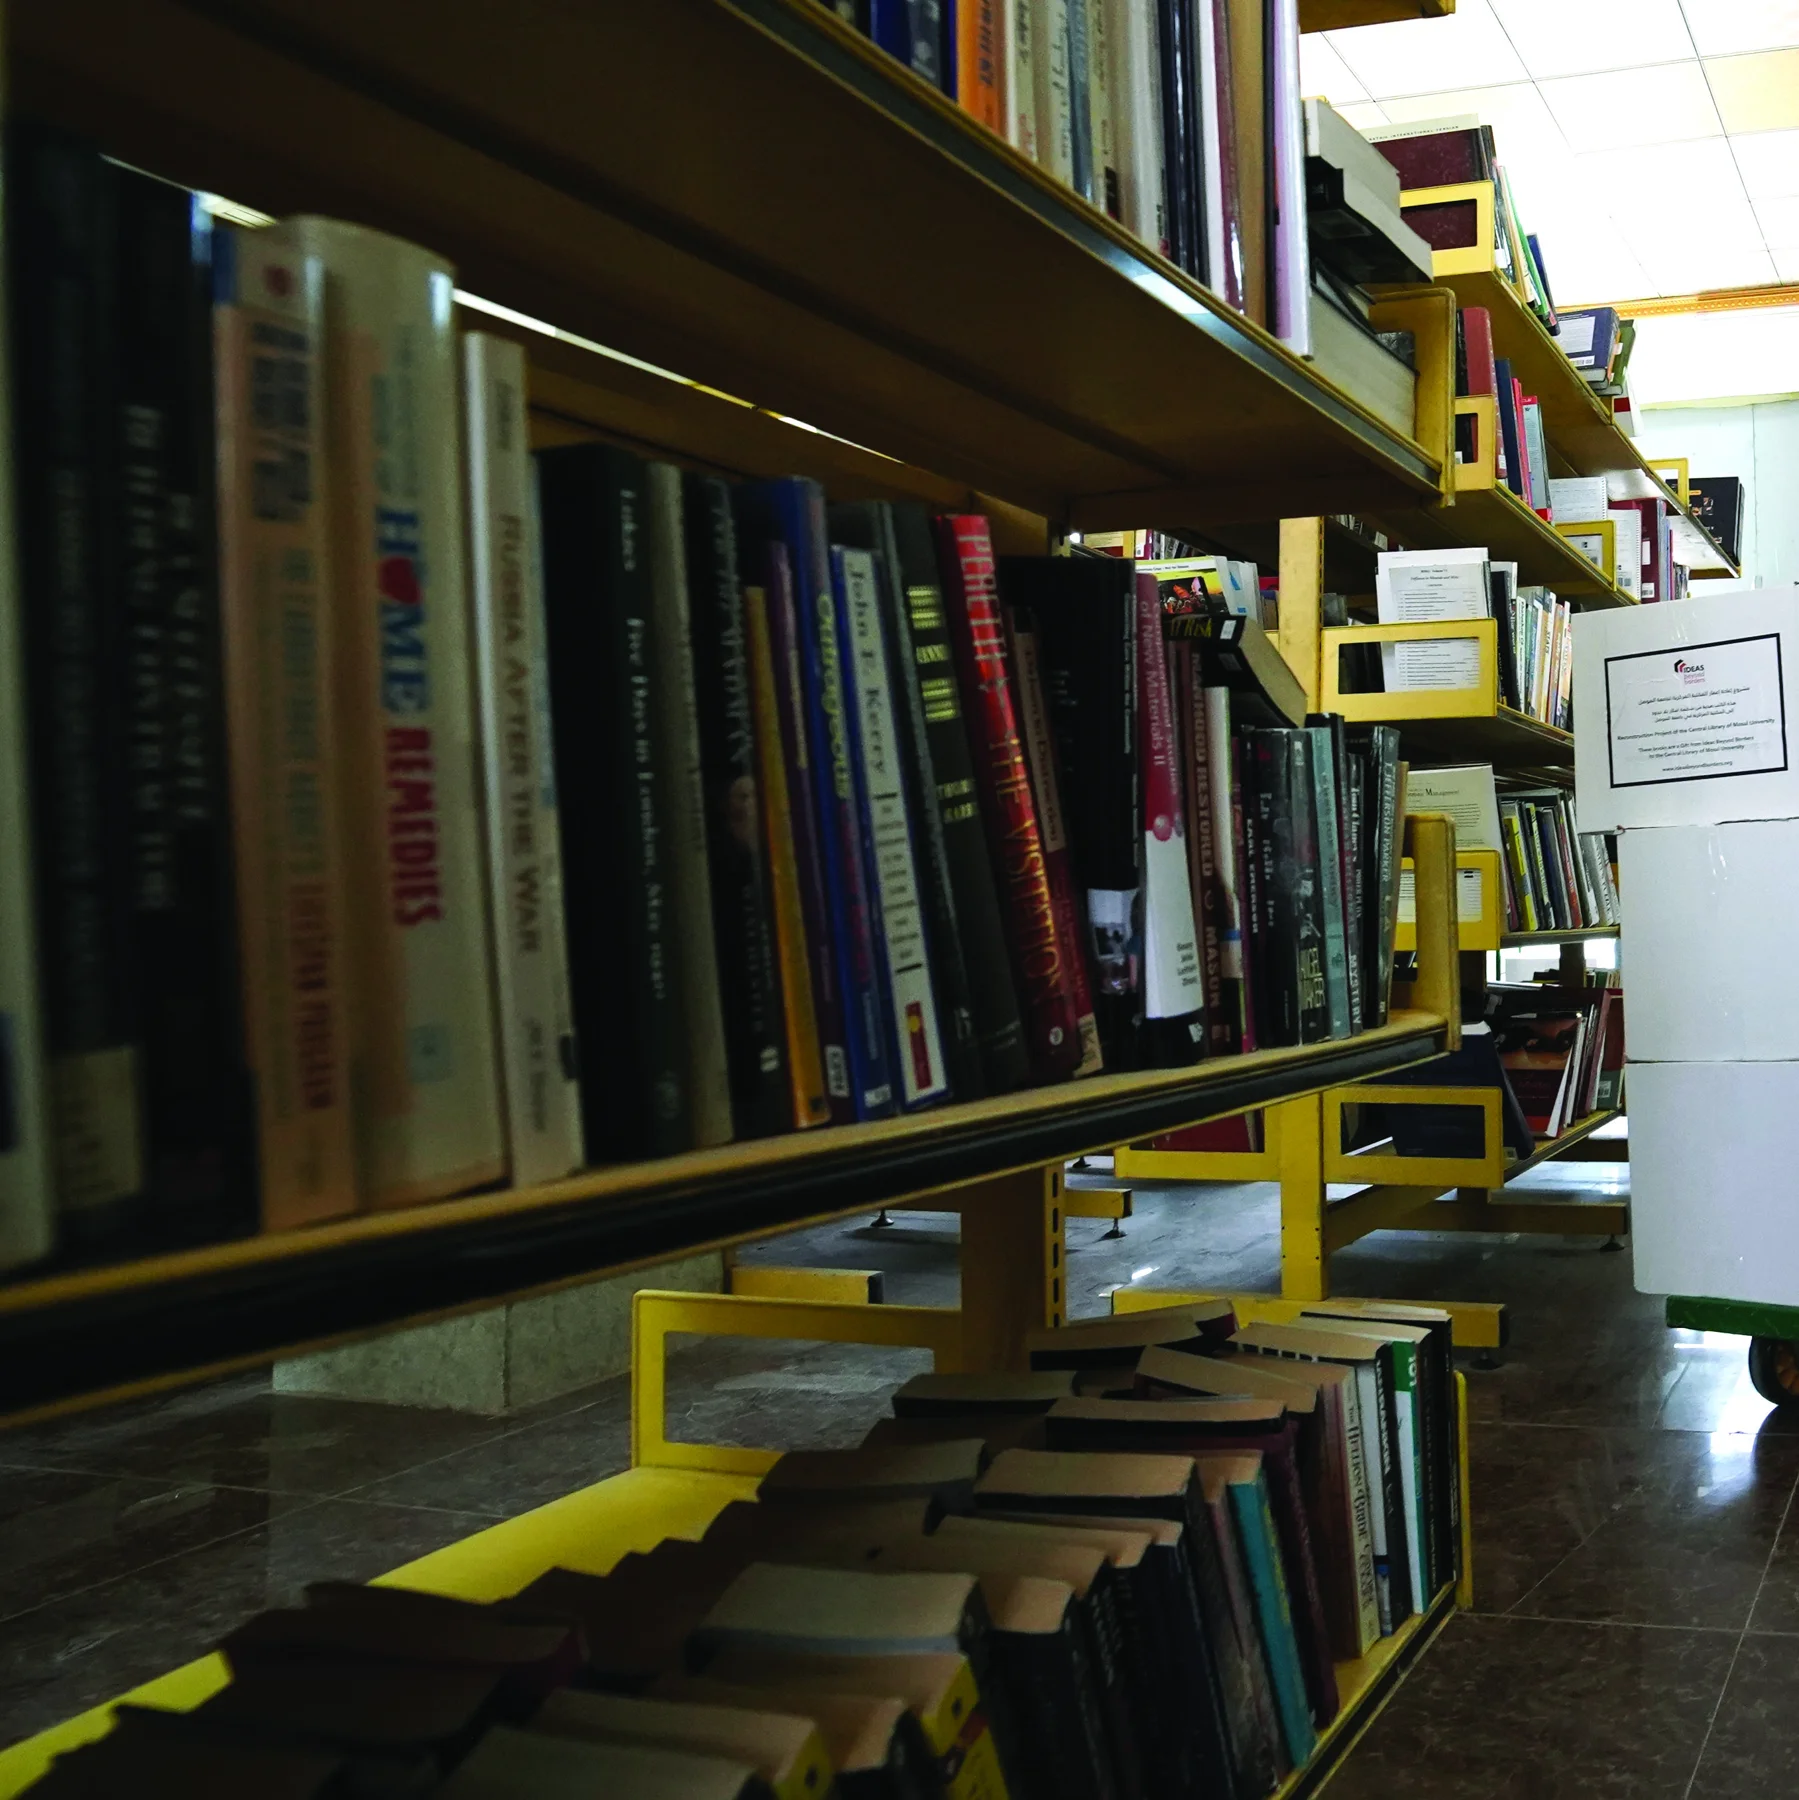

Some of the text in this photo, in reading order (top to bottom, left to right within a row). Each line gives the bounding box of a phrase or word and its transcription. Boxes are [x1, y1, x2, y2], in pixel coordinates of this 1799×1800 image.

[373, 506, 434, 715] HOME
[625, 618, 646, 667] Five
[847, 563, 869, 637] John
[865, 687, 888, 775] Kerry
[1139, 601, 1166, 766] of New Materials II
[1684, 664, 1705, 673] IDEAS
[496, 513, 545, 953] RUSSIA AFTER THE WAR
[631, 675, 650, 733] Days
[1749, 718, 1775, 726] University
[634, 739, 652, 763] in
[956, 533, 1009, 663] PERETTI
[1003, 818, 1063, 1007] VISITATION
[383, 726, 444, 927] REMEDIES
[1190, 652, 1221, 1009] MANHOOD RESTORED MASON
[1382, 770, 1393, 835] JEFFERSON
[1381, 837, 1392, 882] PARKER
[1349, 954, 1361, 1024] MYSTERY
[1346, 1425, 1362, 1489] HELLION
[1353, 1489, 1368, 1540] BRIDE
